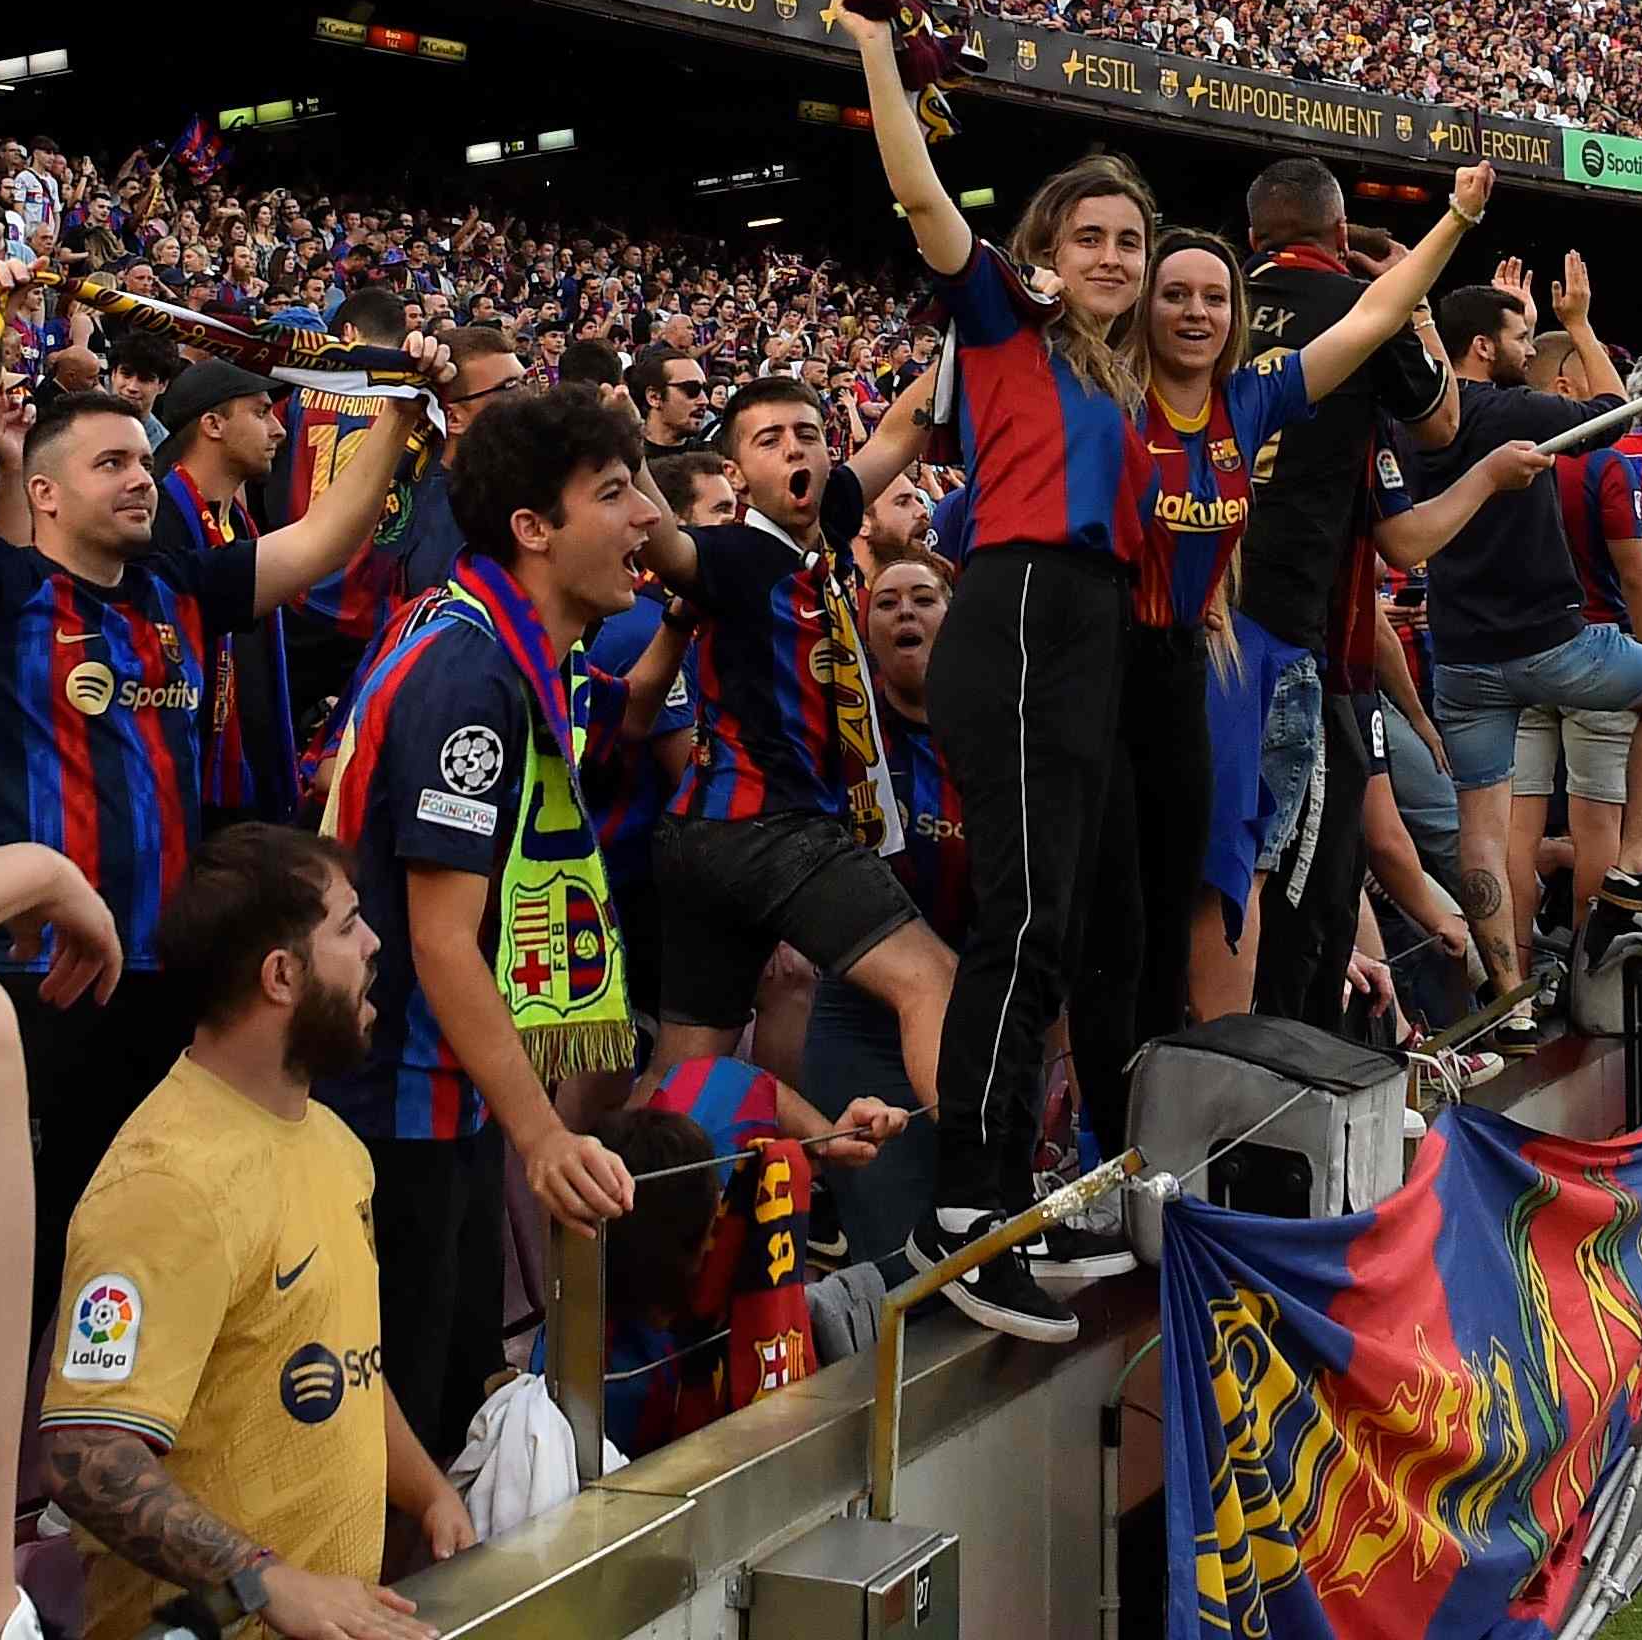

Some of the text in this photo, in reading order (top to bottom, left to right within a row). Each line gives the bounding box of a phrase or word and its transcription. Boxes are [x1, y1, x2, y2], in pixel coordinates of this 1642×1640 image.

[1250, 305, 1295, 338] EX
[117, 679, 199, 712] Spotify
[468, 749, 480, 773] 5
[421, 798, 494, 827] FOUNDATION
[551, 921, 567, 973] FCB
[70, 1348, 127, 1370] LaLiga
[917, 1575, 930, 1611] 27
